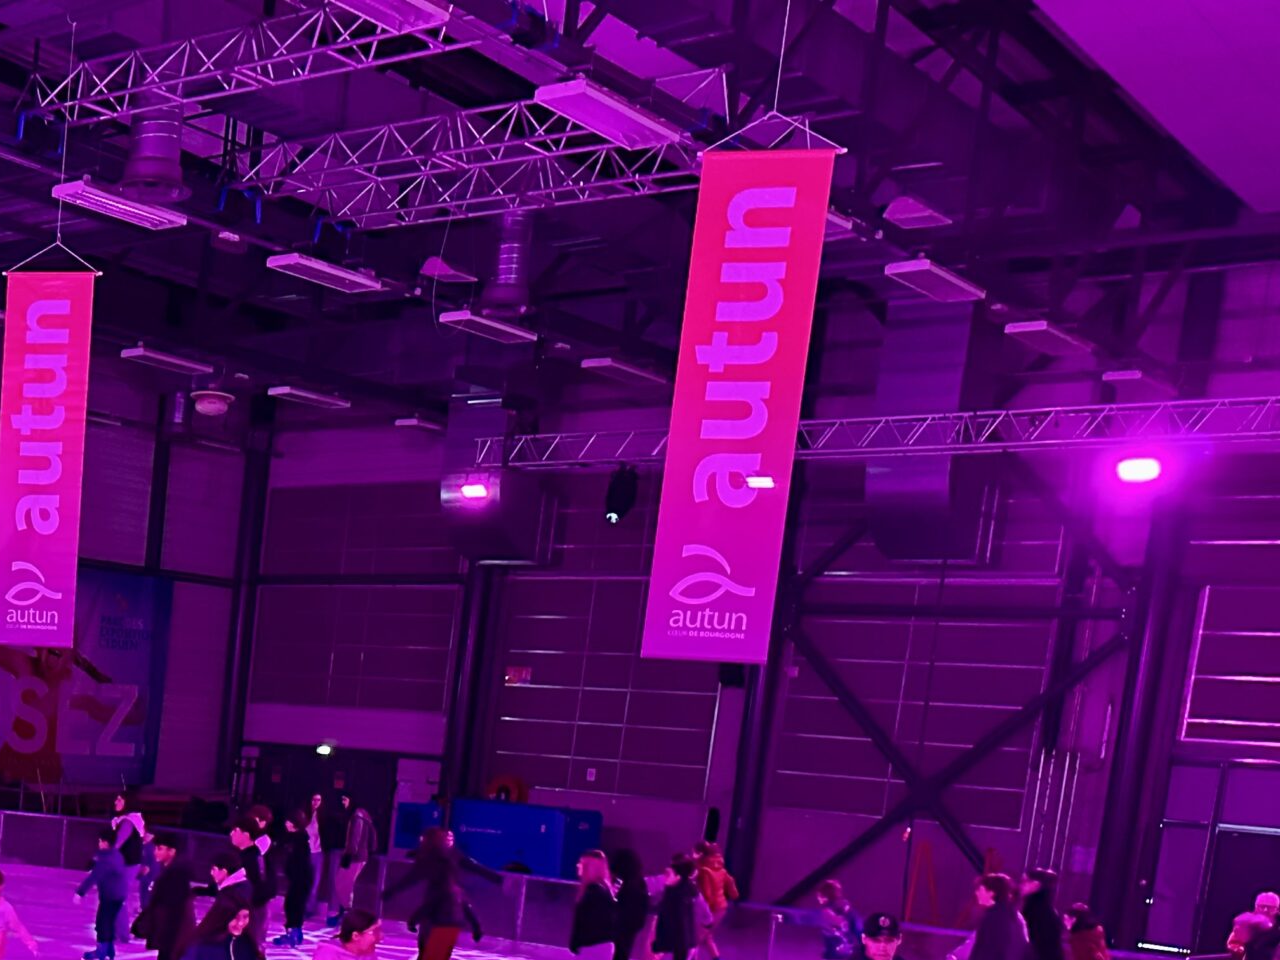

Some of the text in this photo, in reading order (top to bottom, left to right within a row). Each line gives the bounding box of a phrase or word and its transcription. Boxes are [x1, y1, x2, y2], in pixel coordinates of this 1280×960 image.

[693, 186, 797, 508] autun
[11, 298, 71, 536] autun
[6, 608, 58, 624] autun
[669, 607, 748, 631] autun
